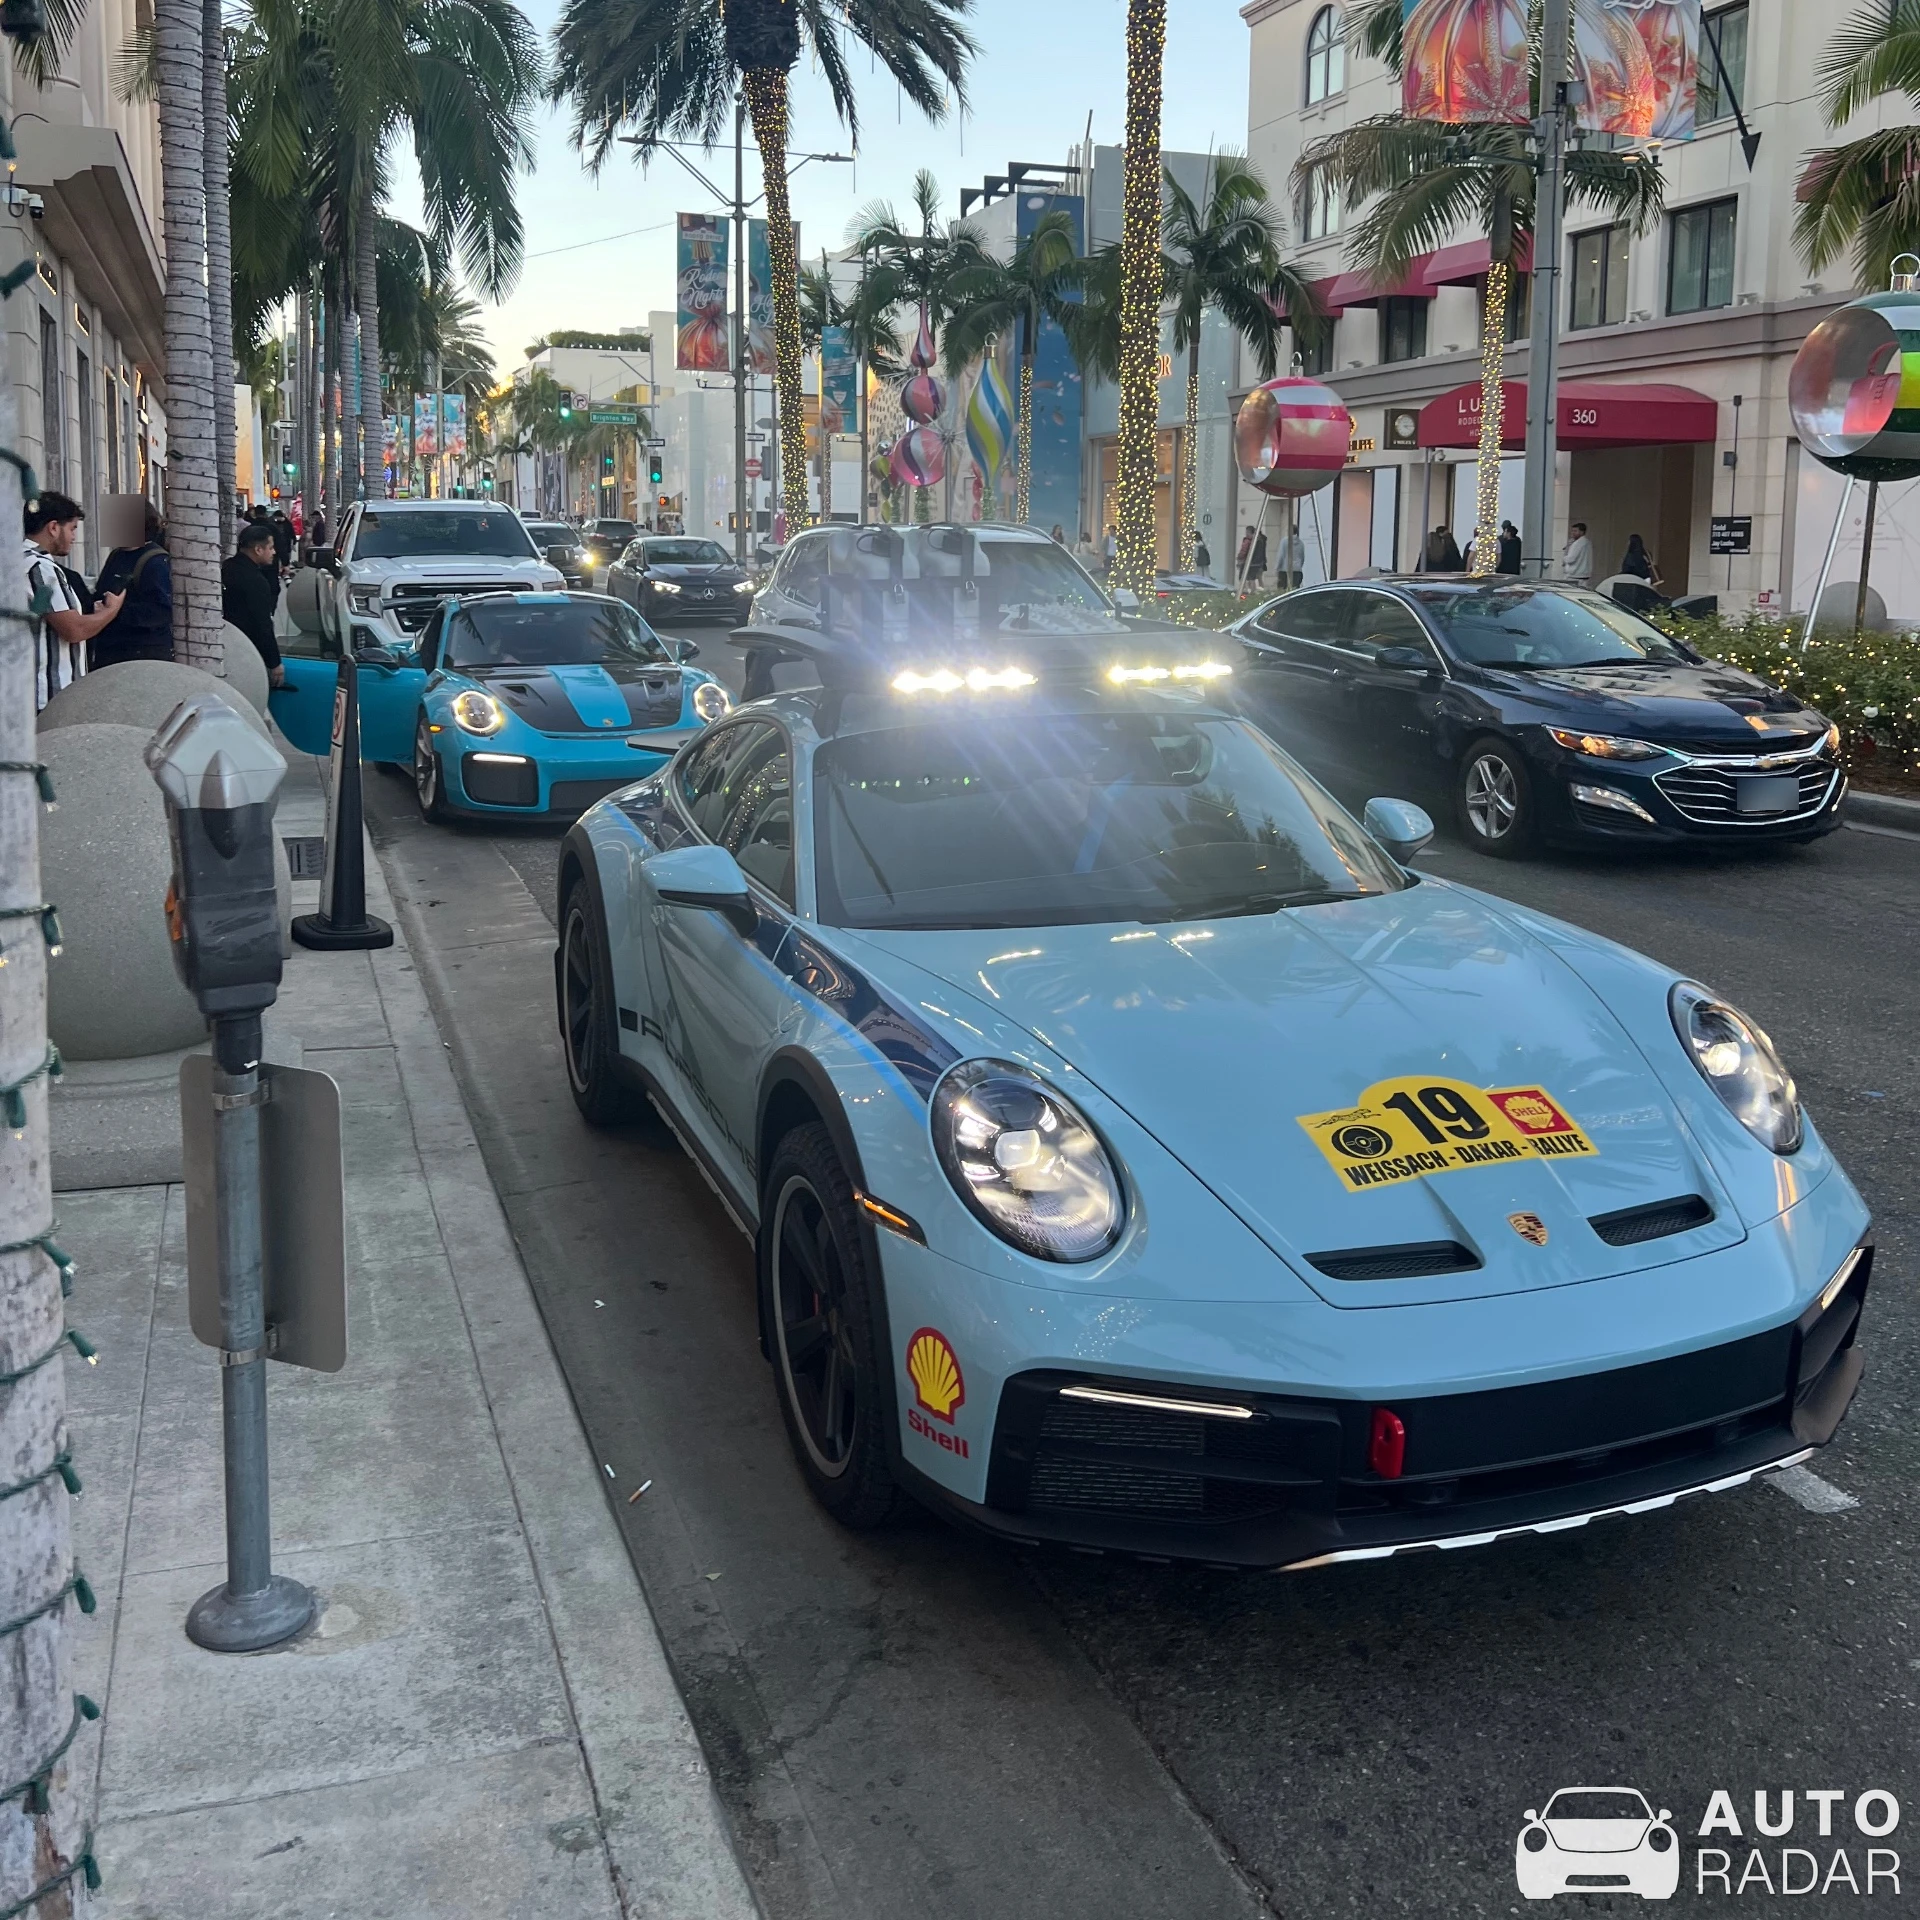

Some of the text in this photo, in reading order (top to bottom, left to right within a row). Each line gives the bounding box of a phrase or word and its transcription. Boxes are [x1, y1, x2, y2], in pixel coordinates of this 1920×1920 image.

[684, 268, 726, 290] Rodeo
[680, 287, 726, 310] Nights
[1459, 394, 1507, 413] LUE
[592, 414, 620, 422] Brighton
[1572, 408, 1597, 424] 360
[1382, 1086, 1490, 1145] 19
[1511, 1106, 1549, 1117] SHELL
[1344, 1150, 1449, 1187] WEISSACH
[1461, 1140, 1523, 1164] DAKAR
[1525, 1133, 1590, 1156] RALLYE
[908, 1408, 969, 1460] Shell
